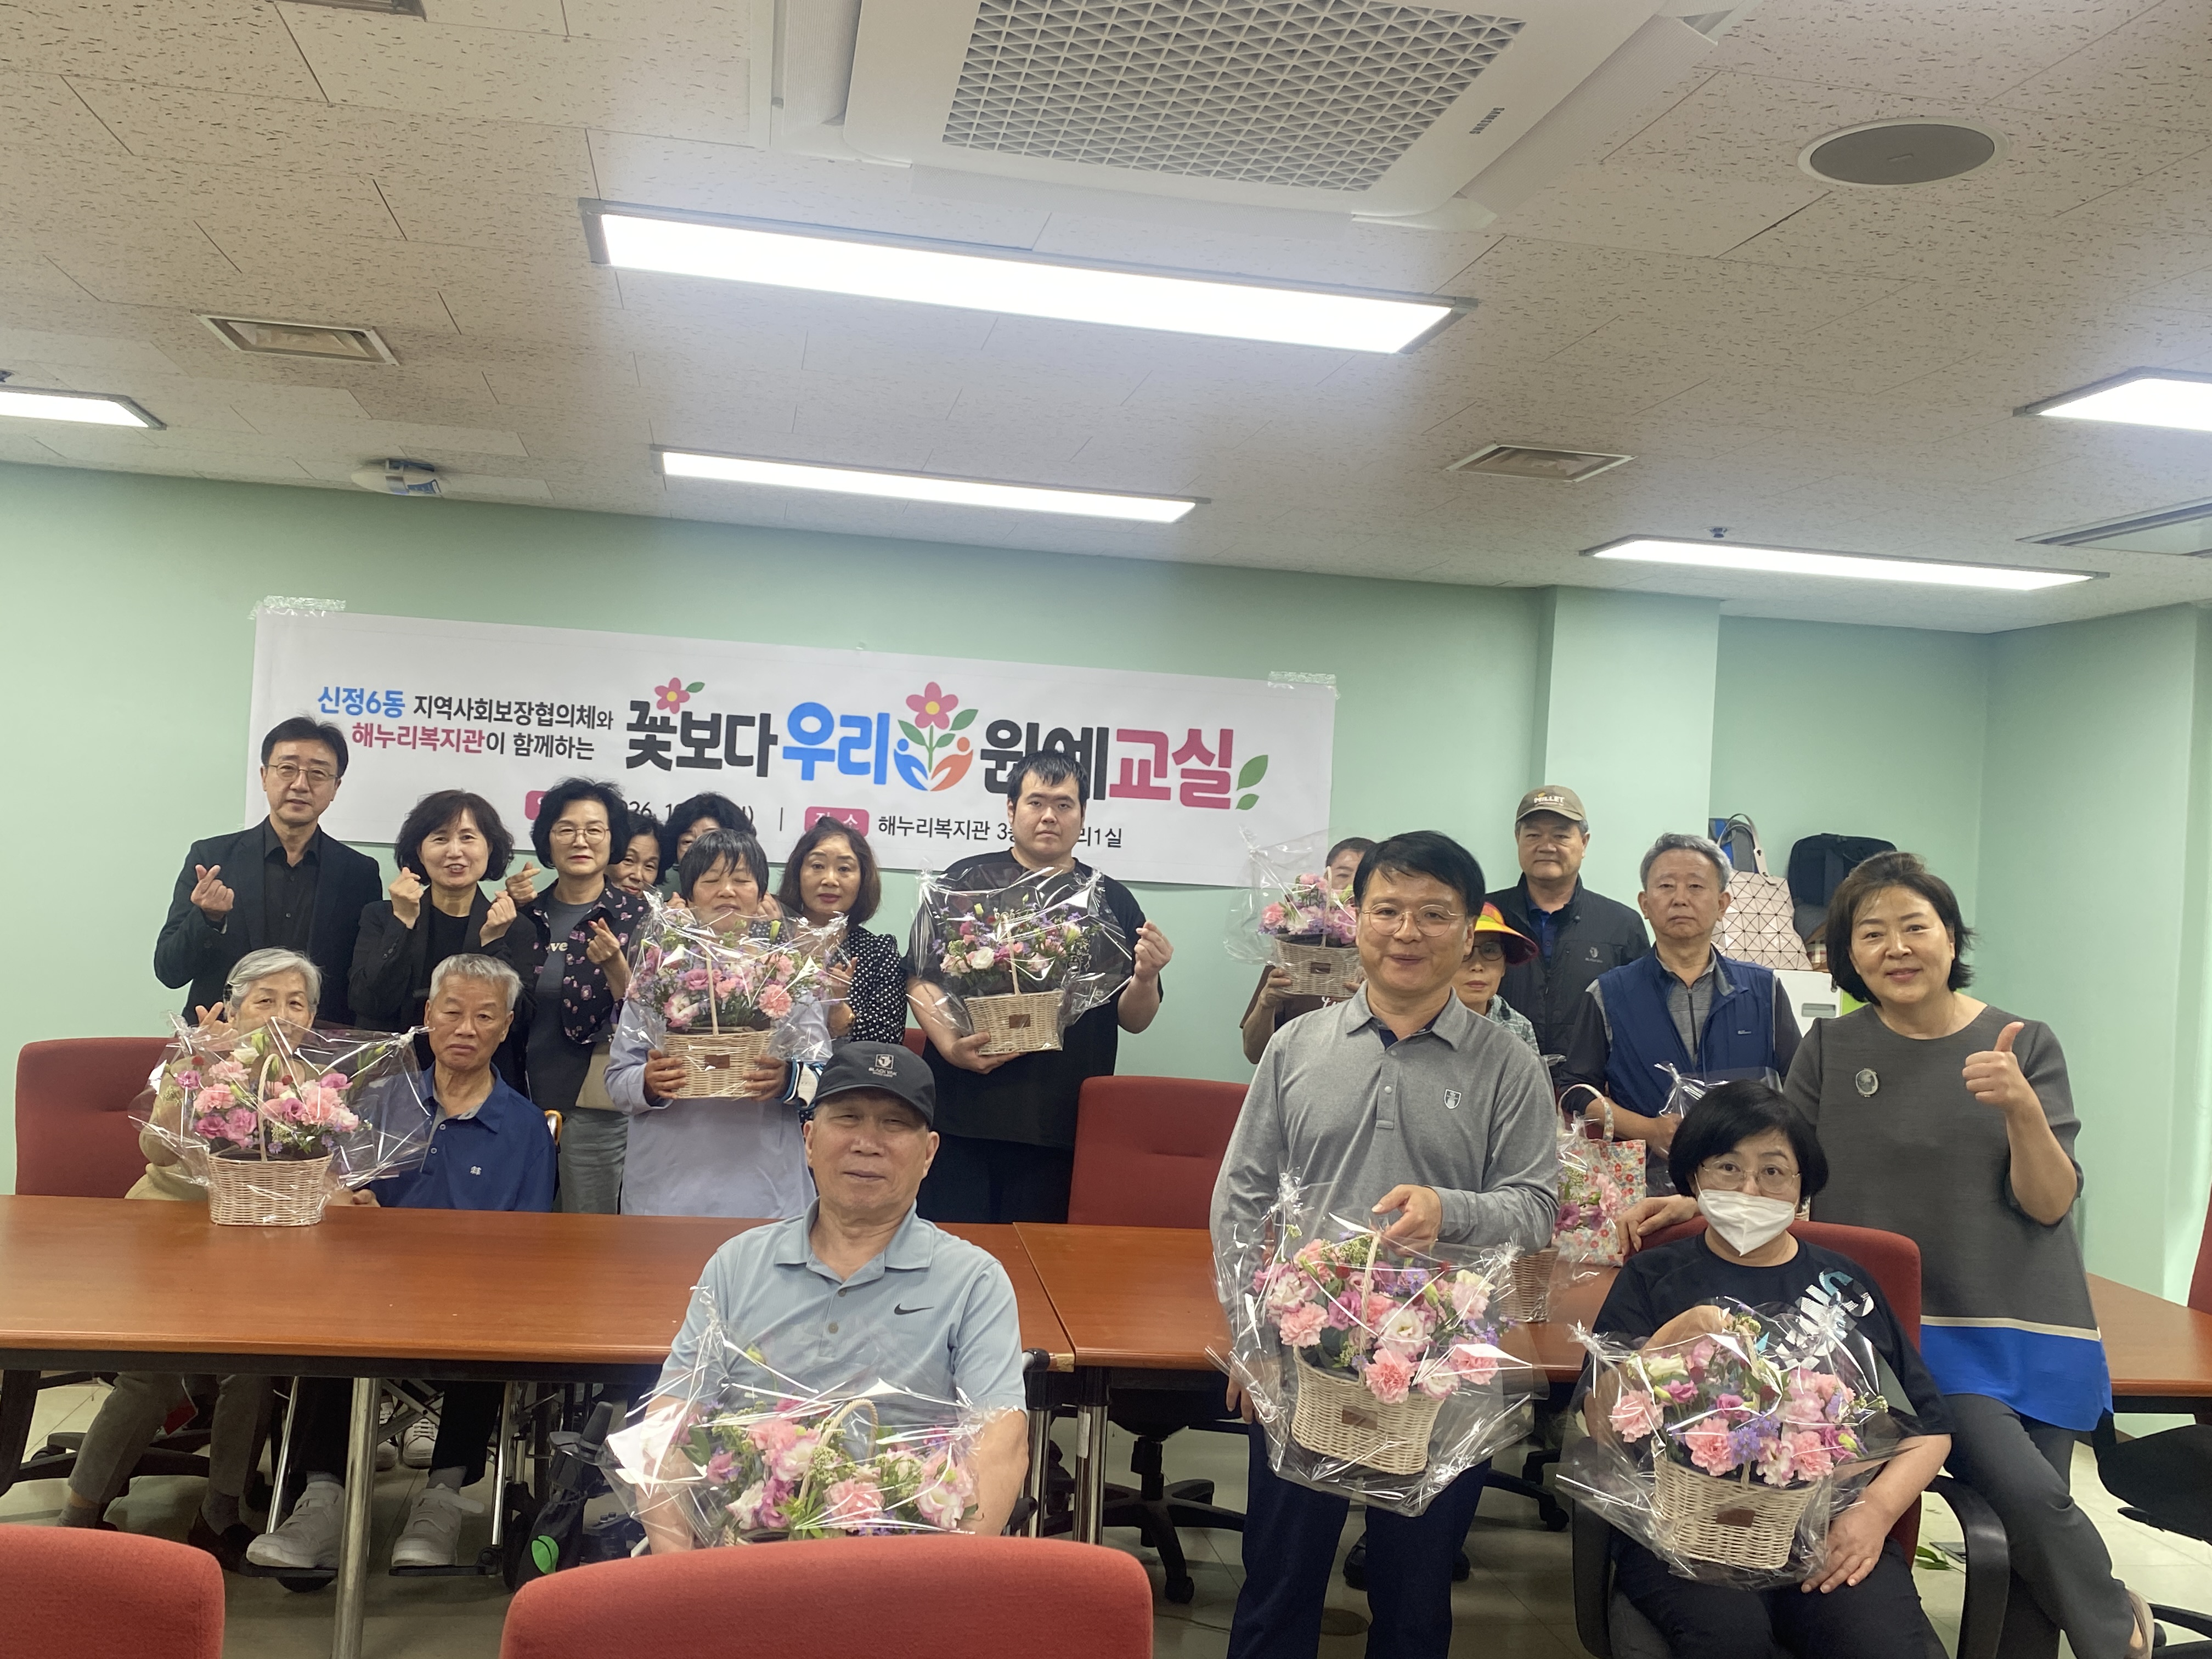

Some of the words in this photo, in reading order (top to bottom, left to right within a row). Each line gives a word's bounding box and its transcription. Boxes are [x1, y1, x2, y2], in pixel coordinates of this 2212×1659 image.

[1469, 108, 1505, 134] SAMSUNG
[317, 686, 406, 718] 신정6동
[413, 695, 613, 730] 지역사회보장협의체와
[352, 722, 505, 754] 해누리복지관이
[513, 732, 595, 760] 함께하는
[783, 702, 890, 785] 우리
[1533, 795, 1565, 804] MILLET
[878, 815, 990, 840] 해누리복지관
[1076, 826, 1121, 848] 리1실
[550, 942, 568, 952] ve
